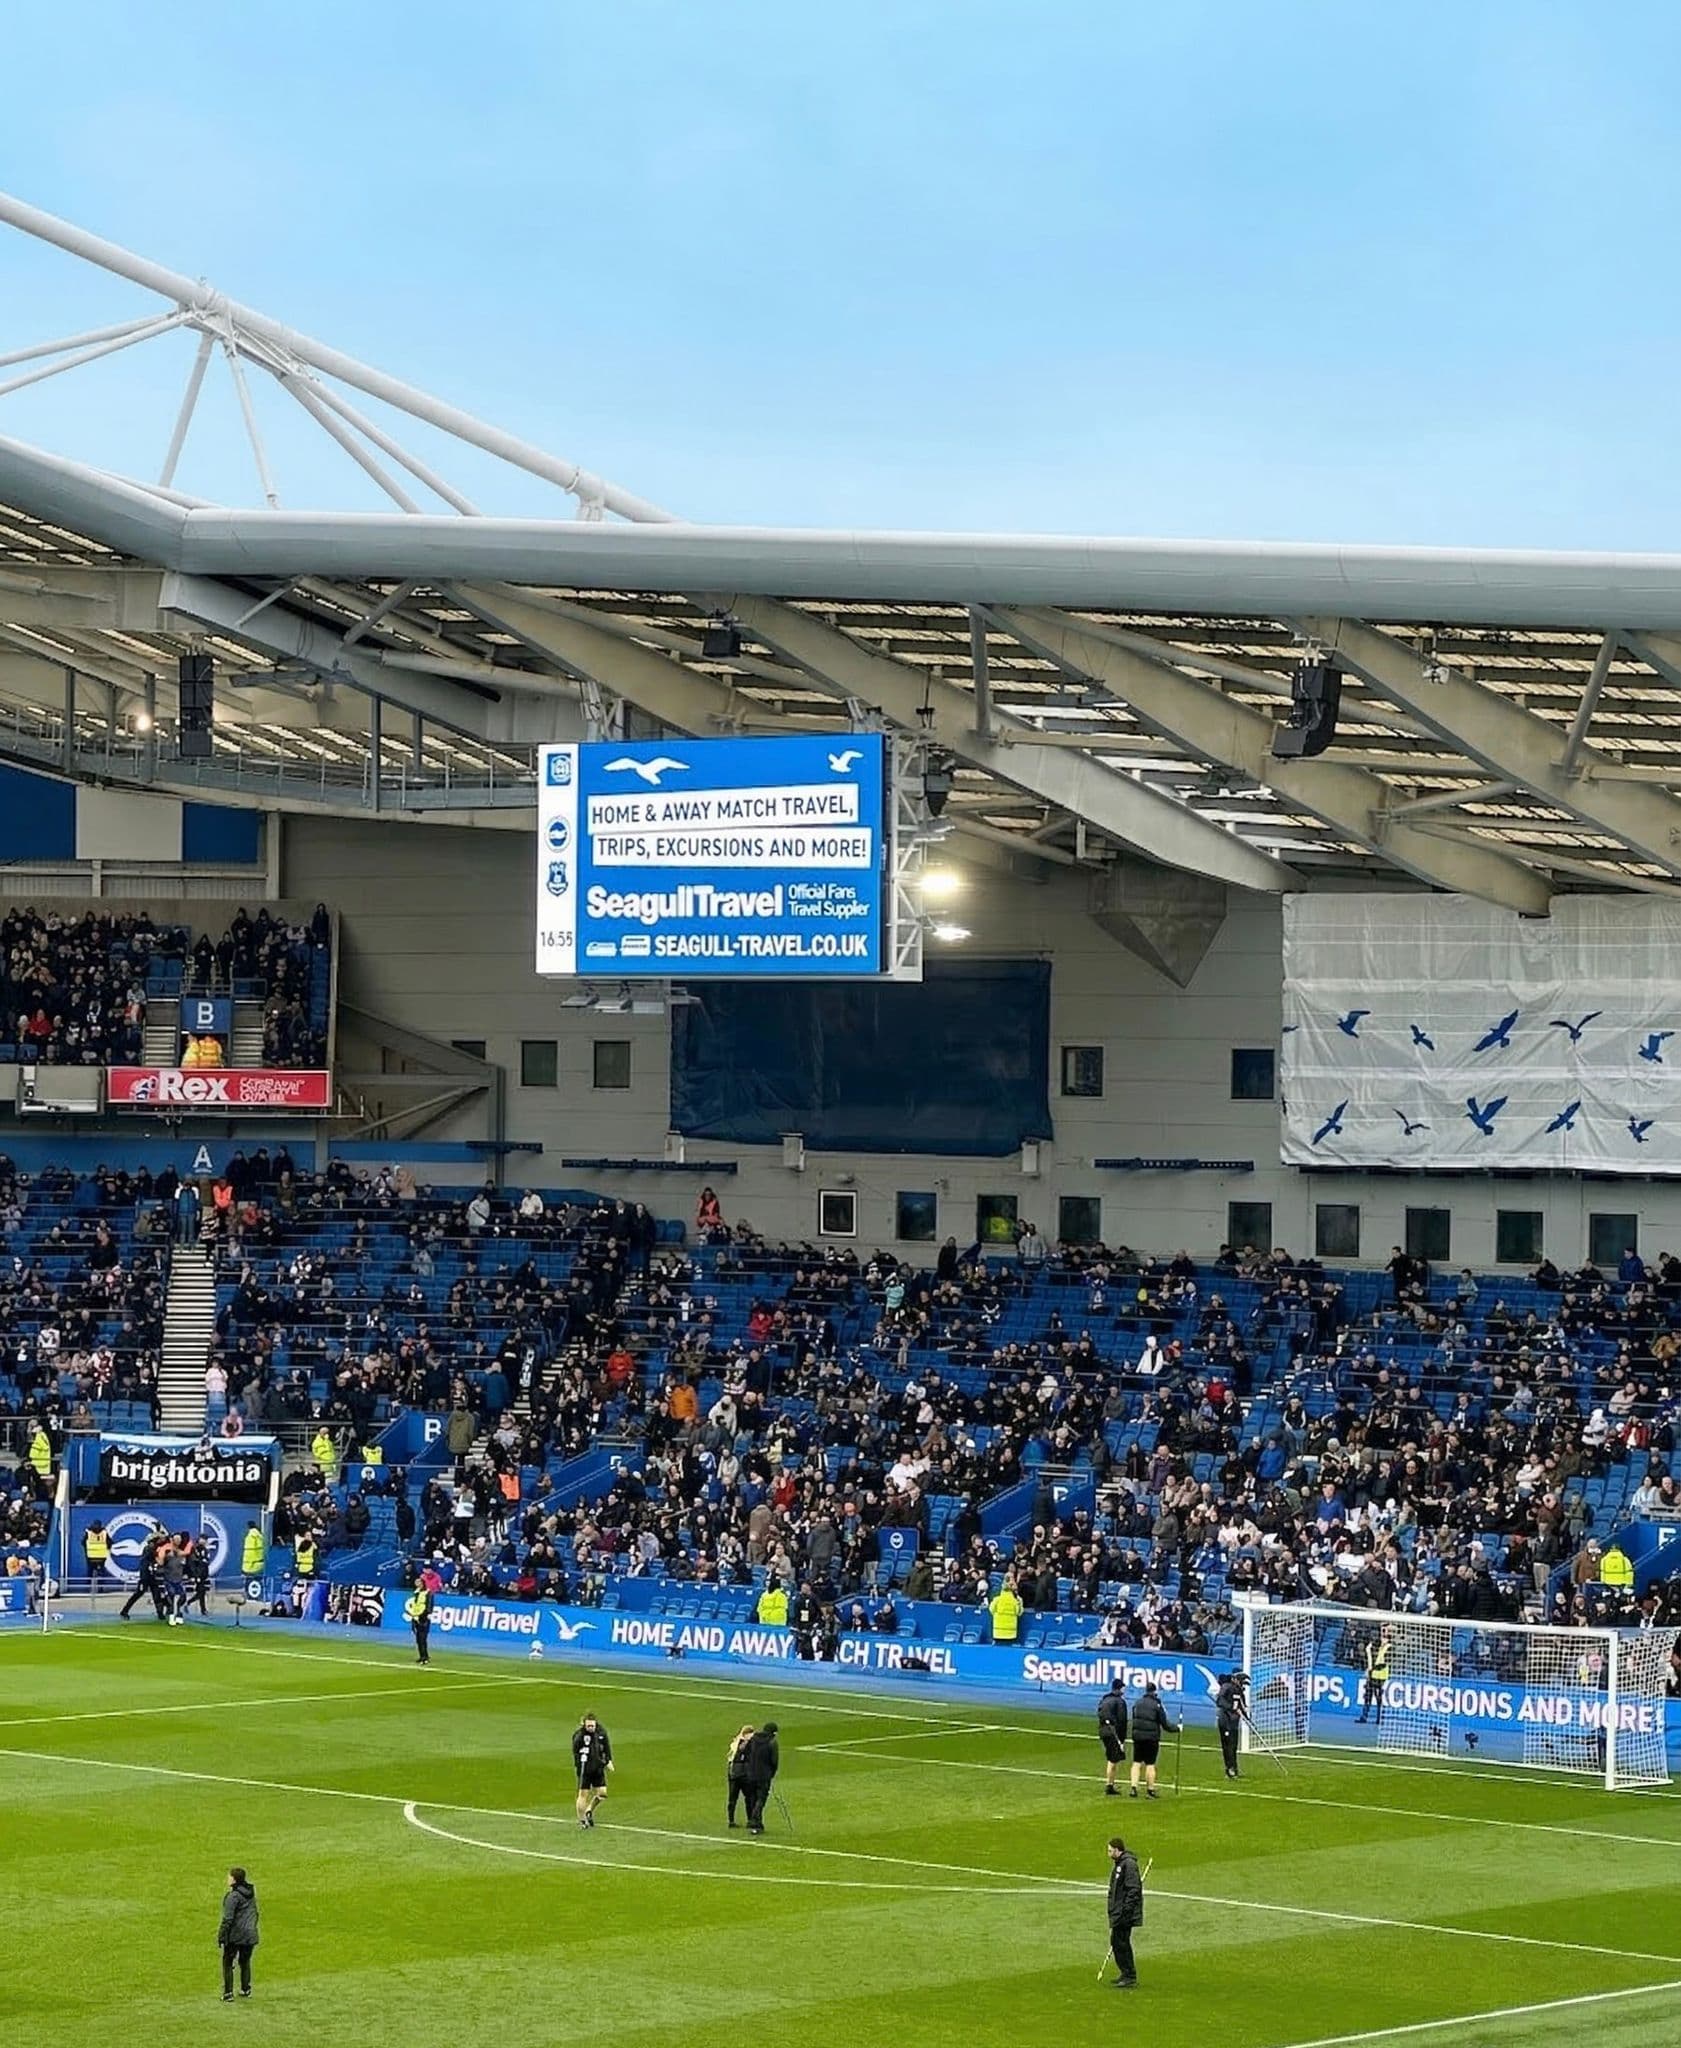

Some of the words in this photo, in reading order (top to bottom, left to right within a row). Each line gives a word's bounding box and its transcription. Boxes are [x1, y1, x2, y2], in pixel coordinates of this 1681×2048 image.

[592, 805, 640, 824] HOME
[645, 804, 657, 821] &
[662, 801, 711, 821] AWAY
[717, 798, 776, 819] MATCH
[782, 795, 853, 817] TRAVEL,
[598, 838, 650, 859] TRIPS,
[656, 838, 763, 856] EXCURSIONS
[770, 838, 805, 857] AND
[812, 839, 866, 857] MORE!
[788, 883, 826, 899] Official
[828, 884, 856, 899] Fans
[788, 901, 821, 916] Travel
[823, 900, 869, 919] Supplier
[655, 934, 868, 956] SEAGULL-TRAVEL.CO.UK
[197, 1002, 214, 1024] B
[159, 1070, 229, 1101] Rex
[193, 1145, 213, 1168] A
[424, 1418, 441, 1443] B
[111, 1456, 260, 1487] brightonia
[612, 1619, 674, 1647] HOME
[677, 1626, 725, 1652] AND
[728, 1630, 794, 1658] AWAY
[1517, 1696, 1572, 1725] AND
